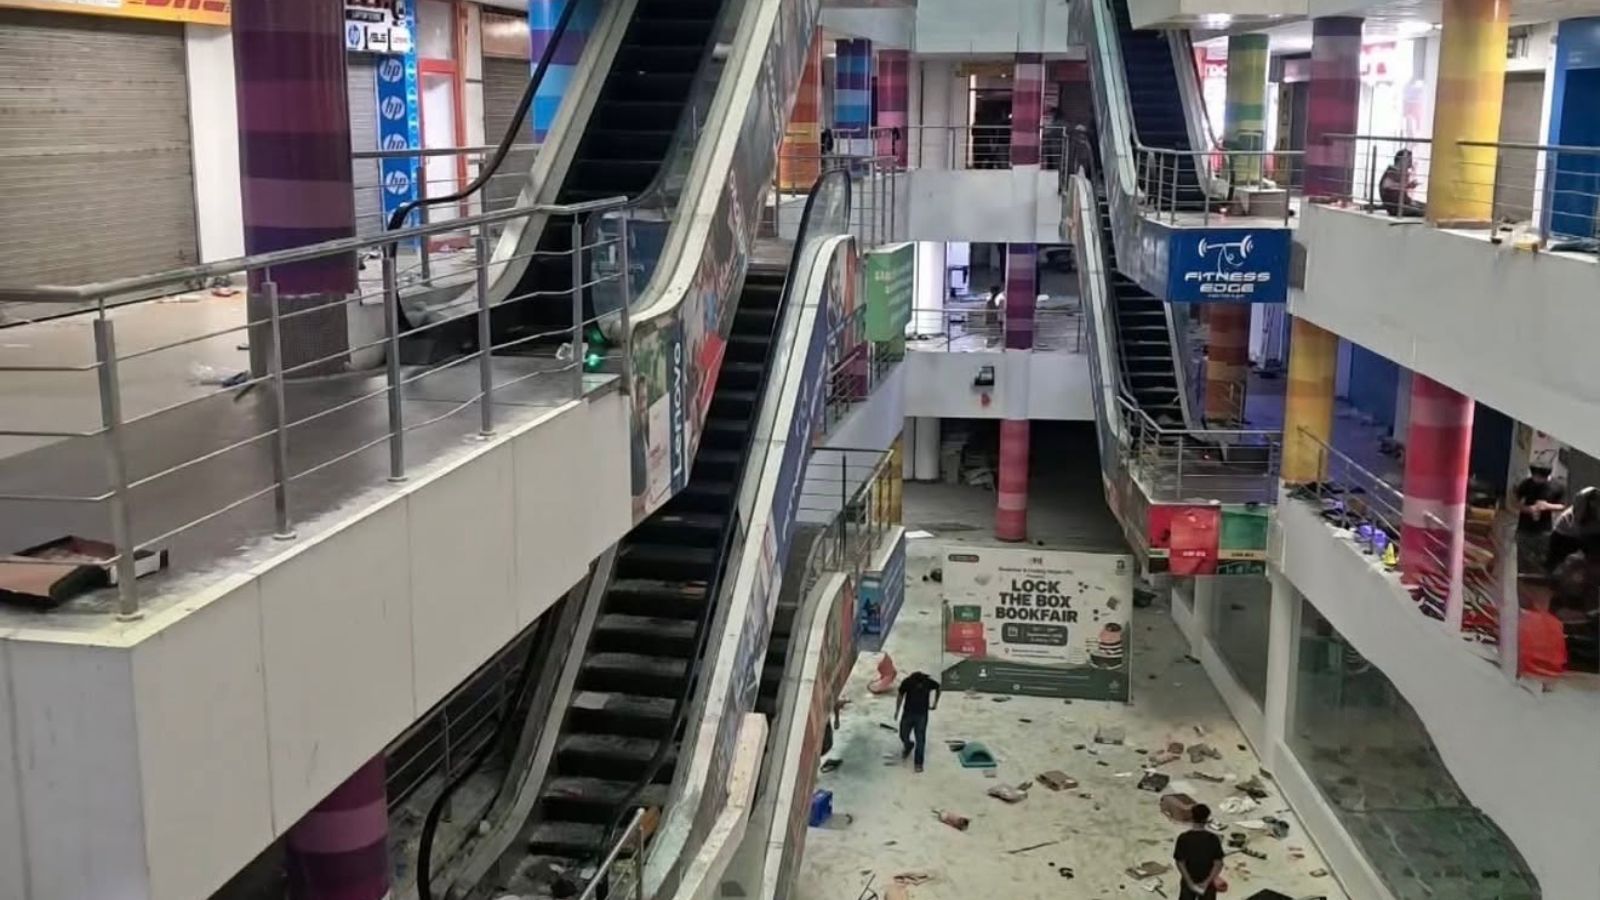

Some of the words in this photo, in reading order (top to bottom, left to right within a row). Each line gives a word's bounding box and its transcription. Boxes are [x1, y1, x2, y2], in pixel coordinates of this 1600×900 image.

[382, 58, 401, 83] hp
[384, 95, 403, 120] hp
[388, 170, 407, 195] hp
[1200, 283, 1254, 293] EDGE
[673, 342, 682, 477] Lenovo
[1011, 579, 1061, 594] LOCK
[999, 592, 1032, 606] THE
[1036, 594, 1072, 609] BOX
[995, 606, 1078, 623] BOOKFAIR
